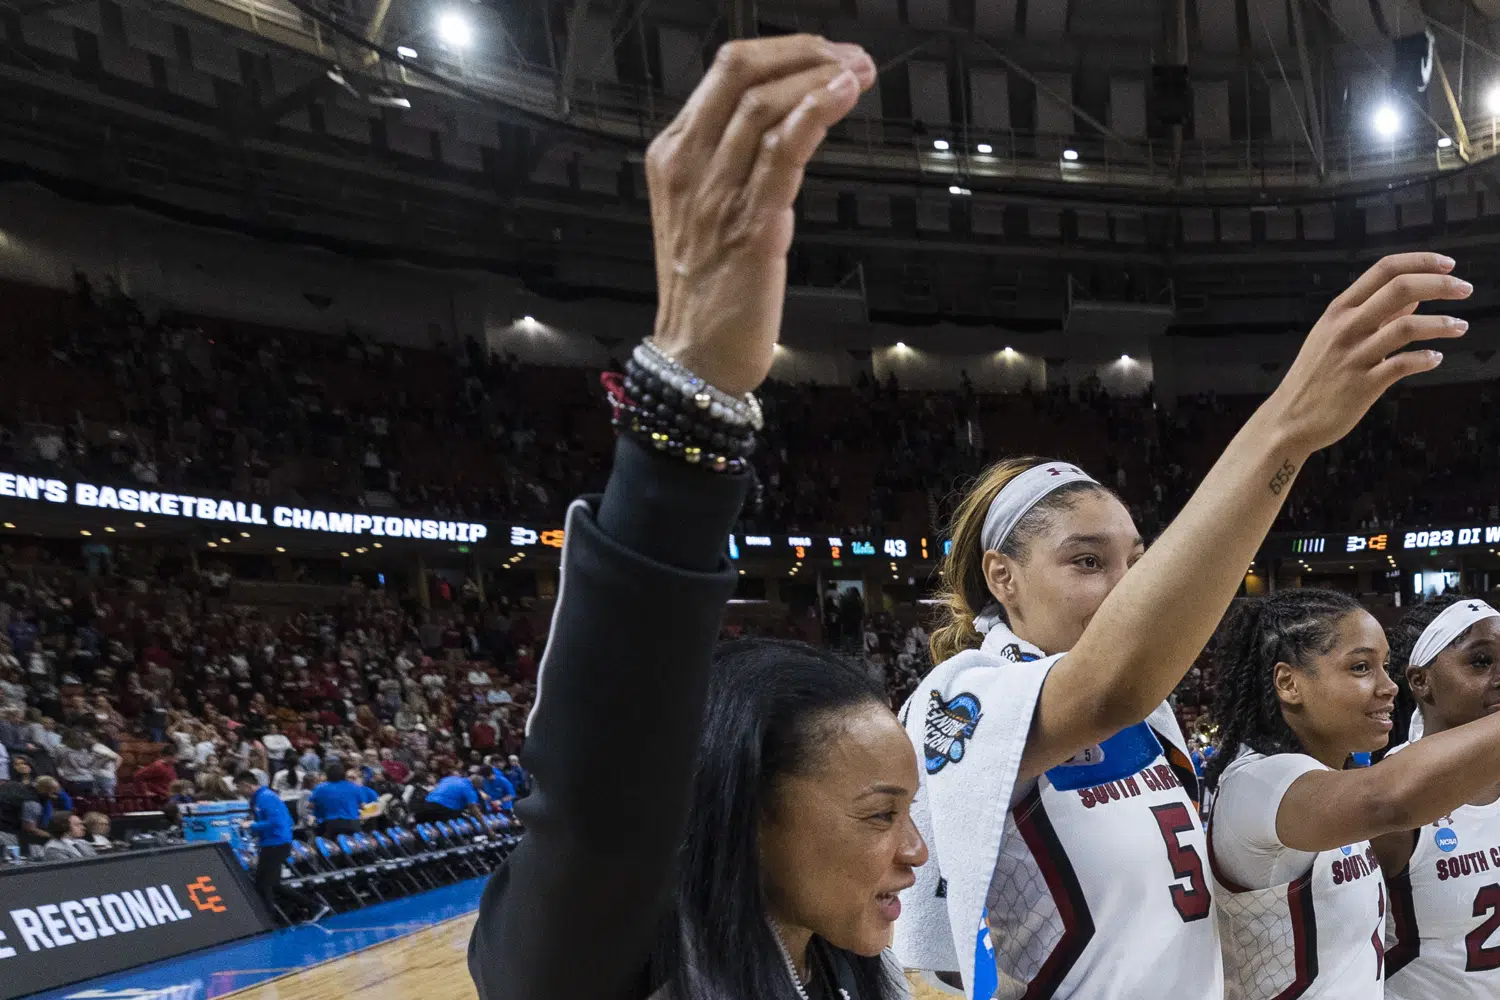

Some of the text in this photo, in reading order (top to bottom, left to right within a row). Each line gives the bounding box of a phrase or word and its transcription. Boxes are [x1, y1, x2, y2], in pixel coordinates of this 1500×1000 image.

[75, 482, 267, 526] BASKETBALL
[273, 506, 488, 543] CHAMPIONSHIP
[884, 539, 907, 557] 43
[1403, 529, 1455, 549] 2023
[1457, 527, 1482, 545] DI
[831, 546, 840, 559] 2
[1084, 748, 1091, 762] 5
[1439, 838, 1457, 847] NCAA
[1148, 802, 1212, 923] 5
[1436, 850, 1490, 881] SOUTH
[9, 884, 192, 952] REGIONAL
